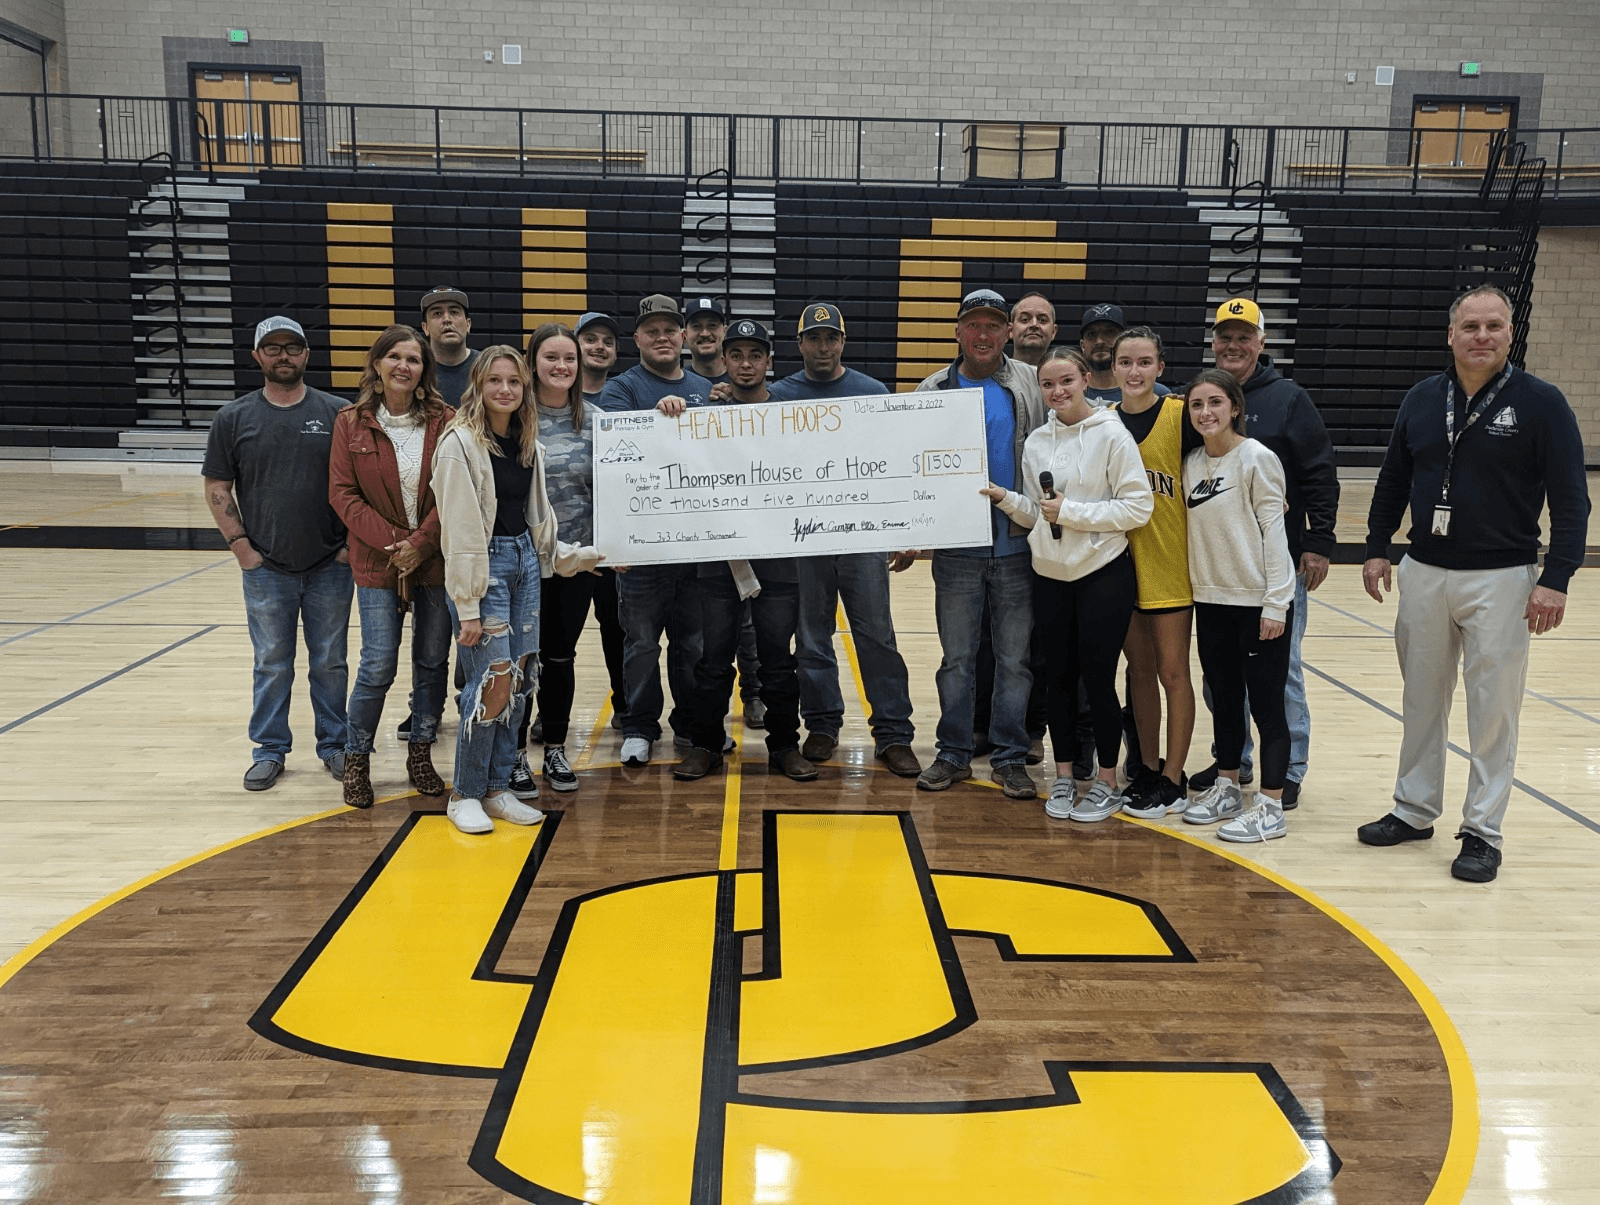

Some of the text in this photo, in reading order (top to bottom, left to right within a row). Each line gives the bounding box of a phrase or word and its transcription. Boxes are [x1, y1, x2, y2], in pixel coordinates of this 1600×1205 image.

[641, 299, 653, 314] NY
[1228, 302, 1244, 315] UC
[853, 399, 877, 414] Date:
[884, 398, 917, 412] November
[925, 398, 944, 408] 2022
[614, 415, 655, 425] FITNESS
[677, 404, 842, 440] HEALTHY HOOPS
[625, 472, 661, 485] Pay to the
[659, 463, 746, 490] Thompsen
[751, 460, 803, 483] House
[815, 460, 835, 480] of
[846, 456, 887, 479] Hope
[636, 482, 660, 492] order of
[1191, 477, 1225, 495] NIKE
[670, 495, 749, 511] thousand
[763, 492, 795, 507] five
[806, 489, 870, 506] hundred
[912, 490, 936, 501] Dollars
[656, 531, 671, 543] 3v3
[675, 531, 700, 542] Charity
[705, 530, 737, 540] Tournament
